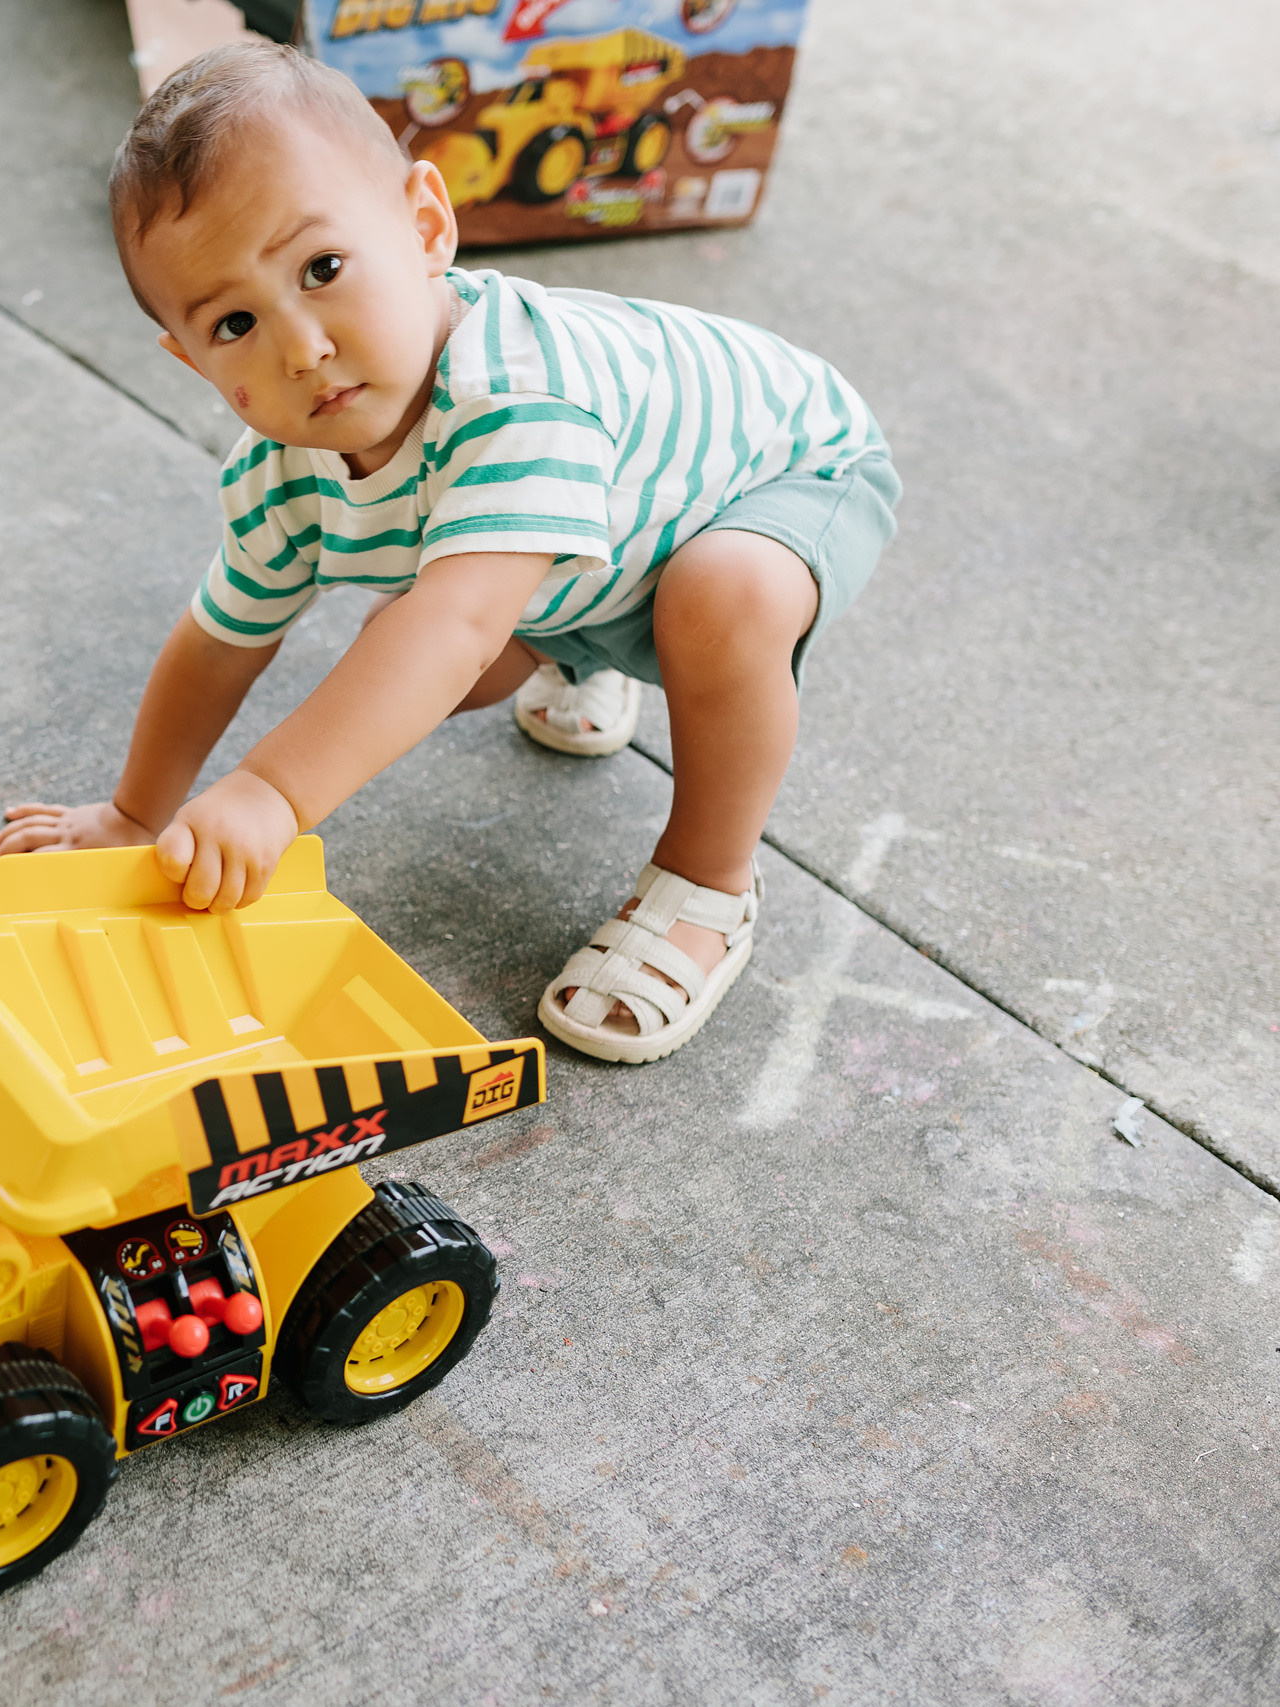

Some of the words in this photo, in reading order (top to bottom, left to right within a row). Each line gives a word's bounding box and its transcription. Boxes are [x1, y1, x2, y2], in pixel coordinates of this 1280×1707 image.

[471, 1078, 515, 1110] DIG
[218, 1108, 389, 1188] MAXX
[208, 1132, 387, 1210] ACTION
[227, 1382, 243, 1401] R
[154, 1411, 171, 1432] F
